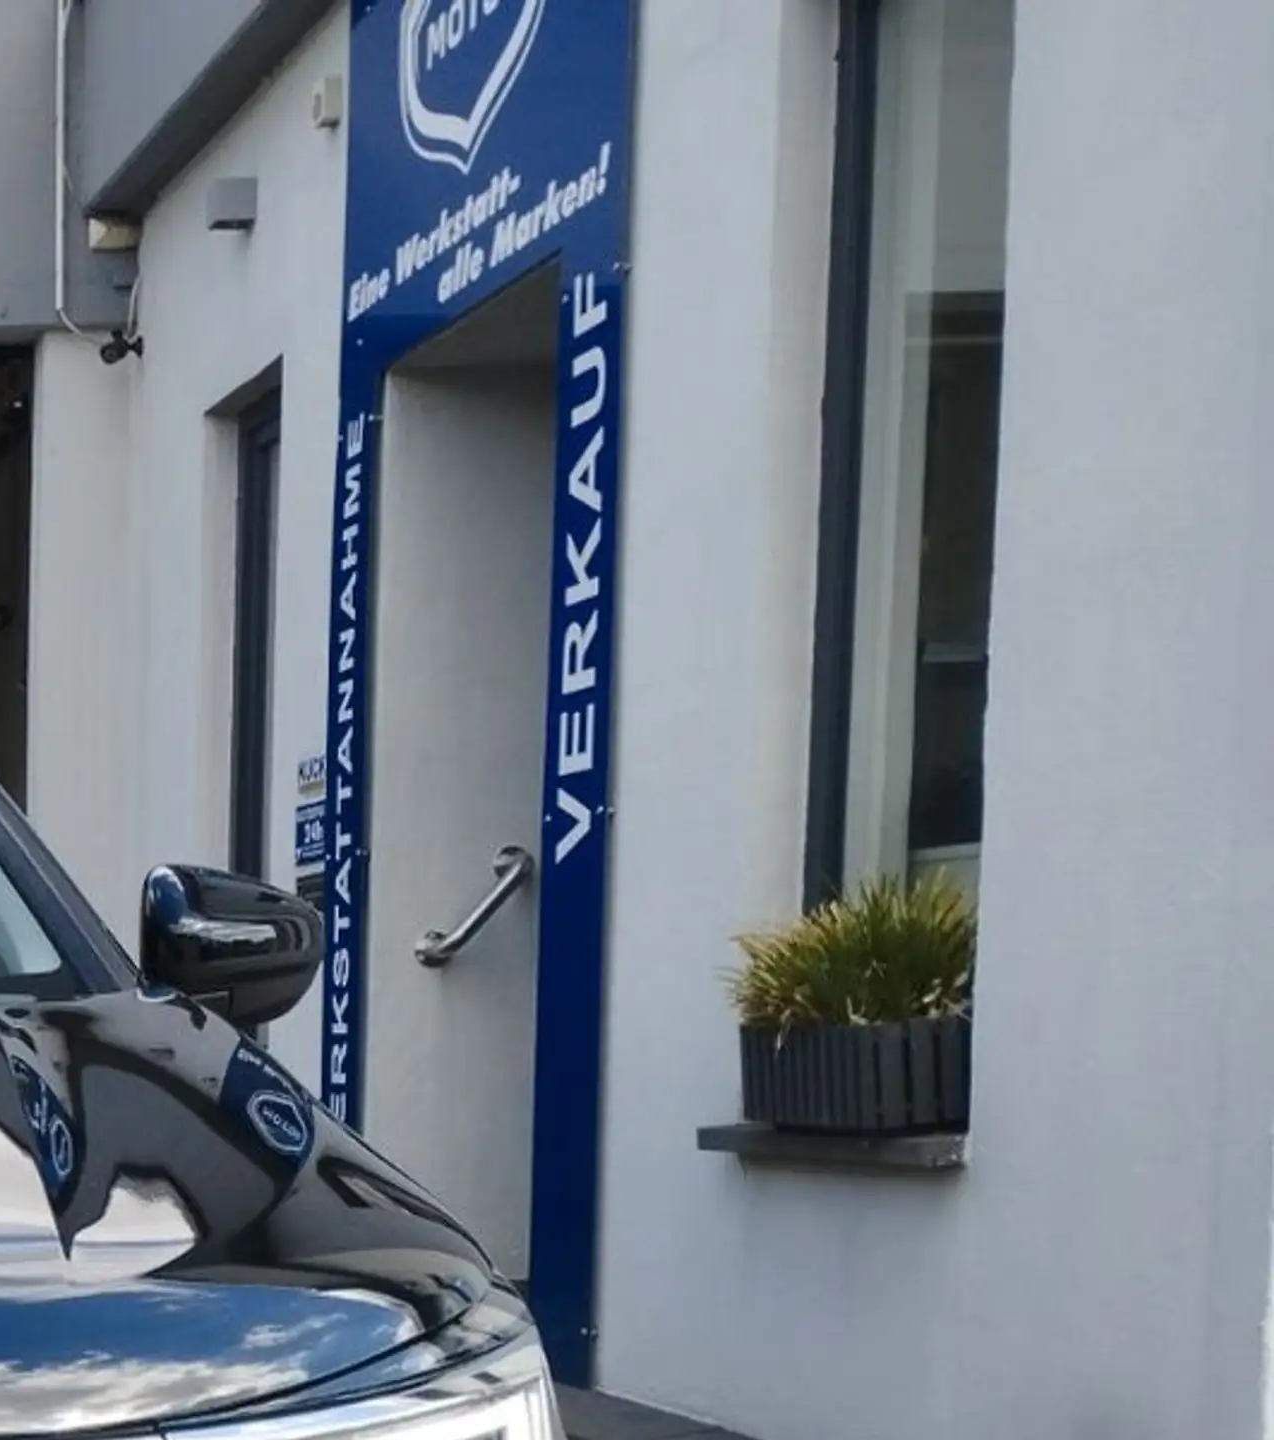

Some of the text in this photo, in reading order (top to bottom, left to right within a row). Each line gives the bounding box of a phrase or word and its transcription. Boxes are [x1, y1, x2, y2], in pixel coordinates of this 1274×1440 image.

[347, 268, 390, 323] Eine
[438, 140, 612, 304] alle Marken!
[554, 272, 608, 865] VERKAUF
[329, 410, 366, 1122] ERKSTATTANNAHME
